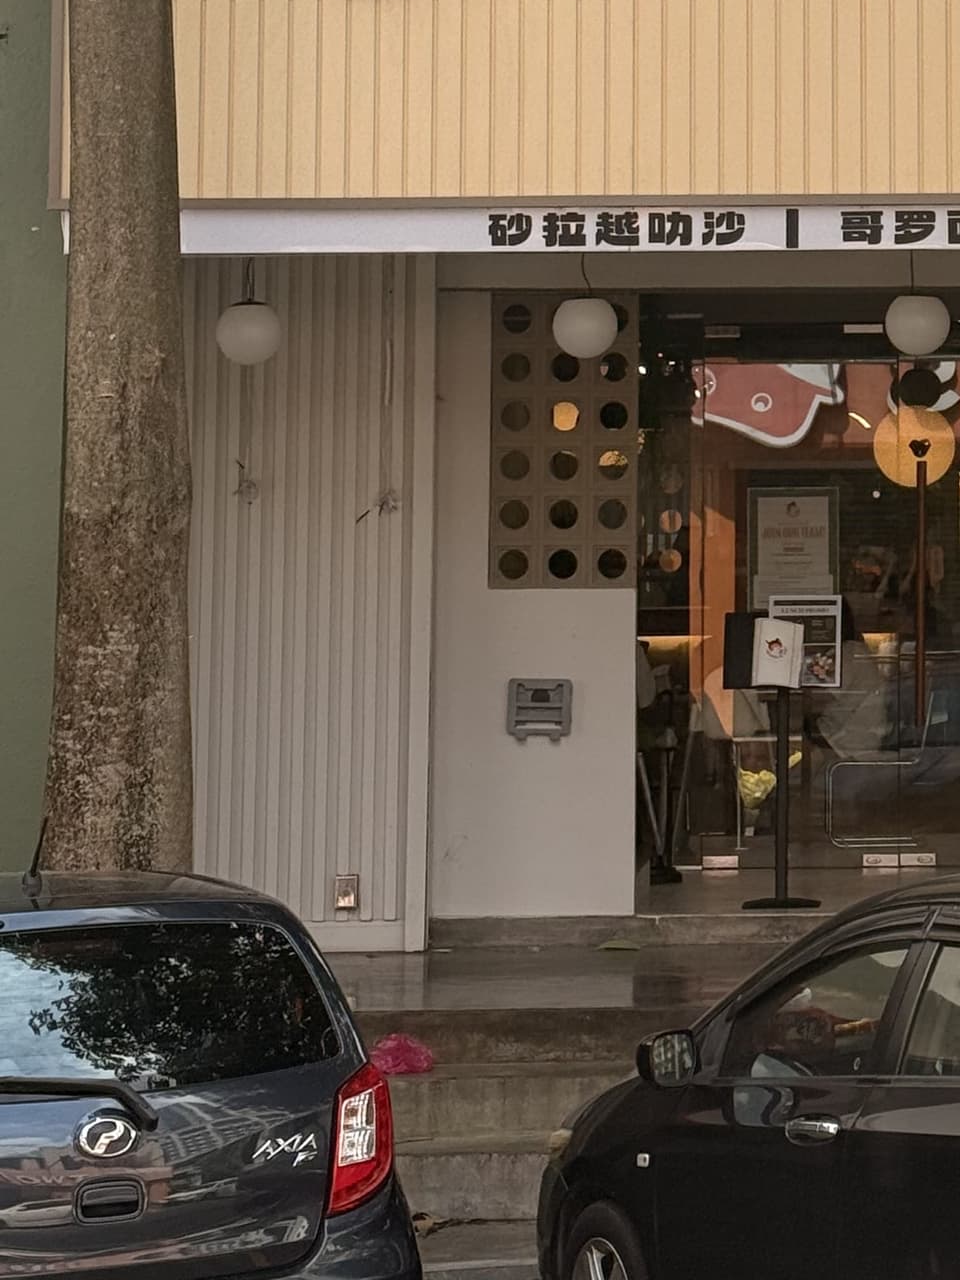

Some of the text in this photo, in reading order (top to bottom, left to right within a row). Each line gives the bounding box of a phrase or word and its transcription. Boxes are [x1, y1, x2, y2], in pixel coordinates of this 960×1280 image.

[488, 210, 746, 247] 砂拉越叻沙
[251, 1132, 318, 1160] AXIA
